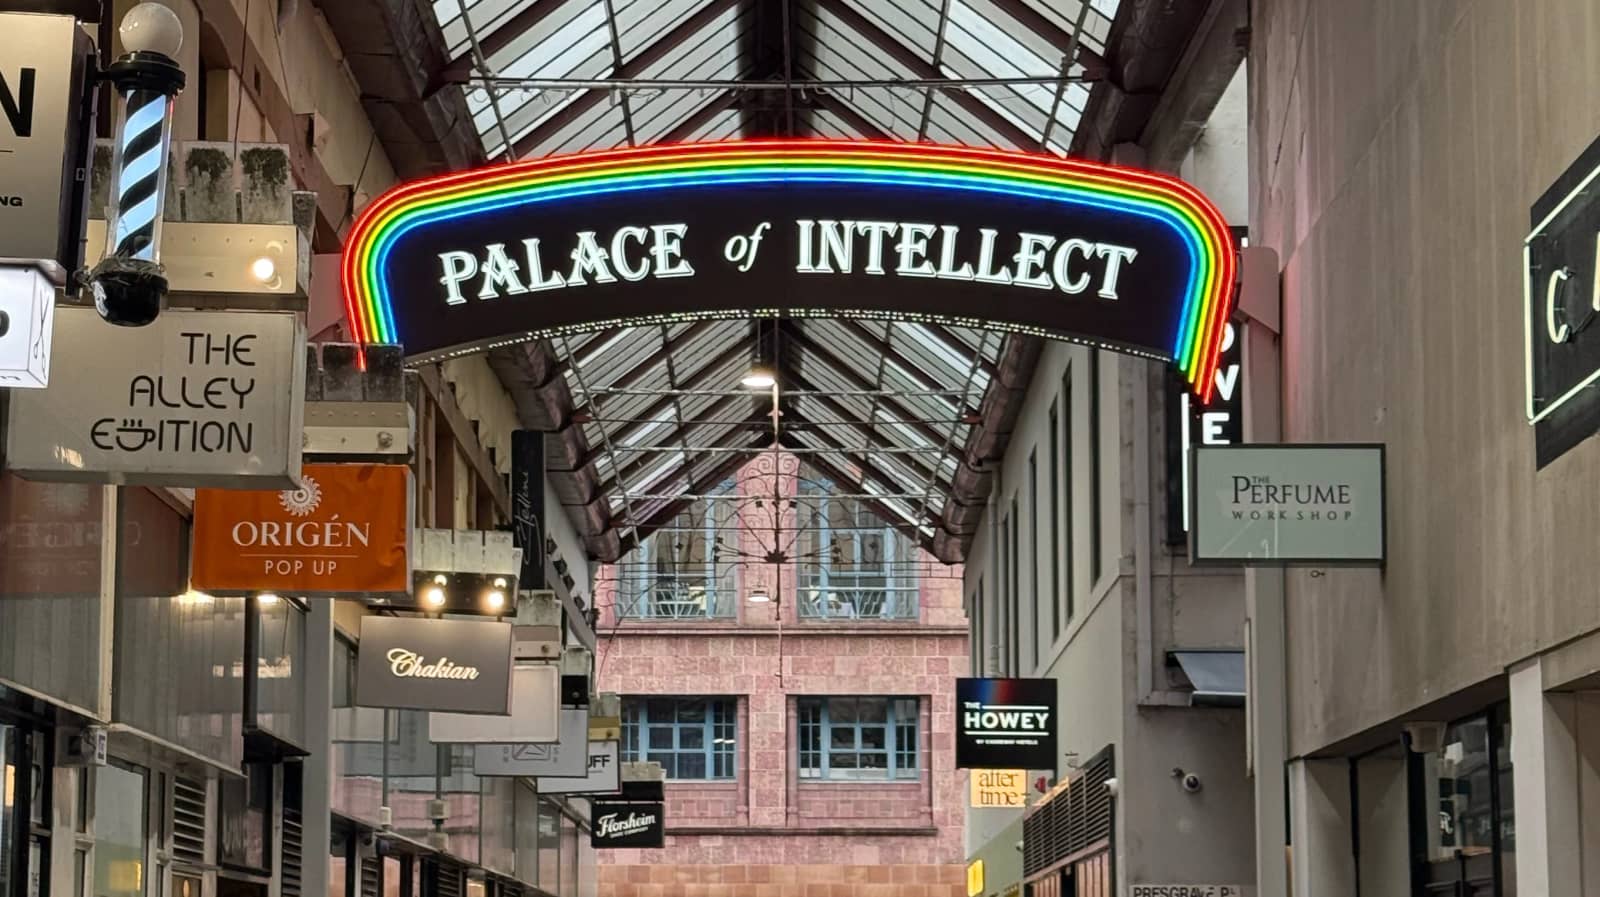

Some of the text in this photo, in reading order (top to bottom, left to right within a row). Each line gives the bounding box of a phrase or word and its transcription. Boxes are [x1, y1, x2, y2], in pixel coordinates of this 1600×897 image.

[438, 219, 1138, 306] PALACE of INTELLECT
[181, 332, 257, 367] THE
[130, 375, 255, 409] ALLEY
[1232, 475, 1352, 504] PERFUME
[231, 513, 371, 547] ORIGÉN
[264, 559, 338, 575] POP UP
[386, 647, 480, 681] Chakian
[964, 711, 1049, 729] HOWEY
[979, 788, 1019, 805] time
[595, 812, 656, 837] Florsheim
